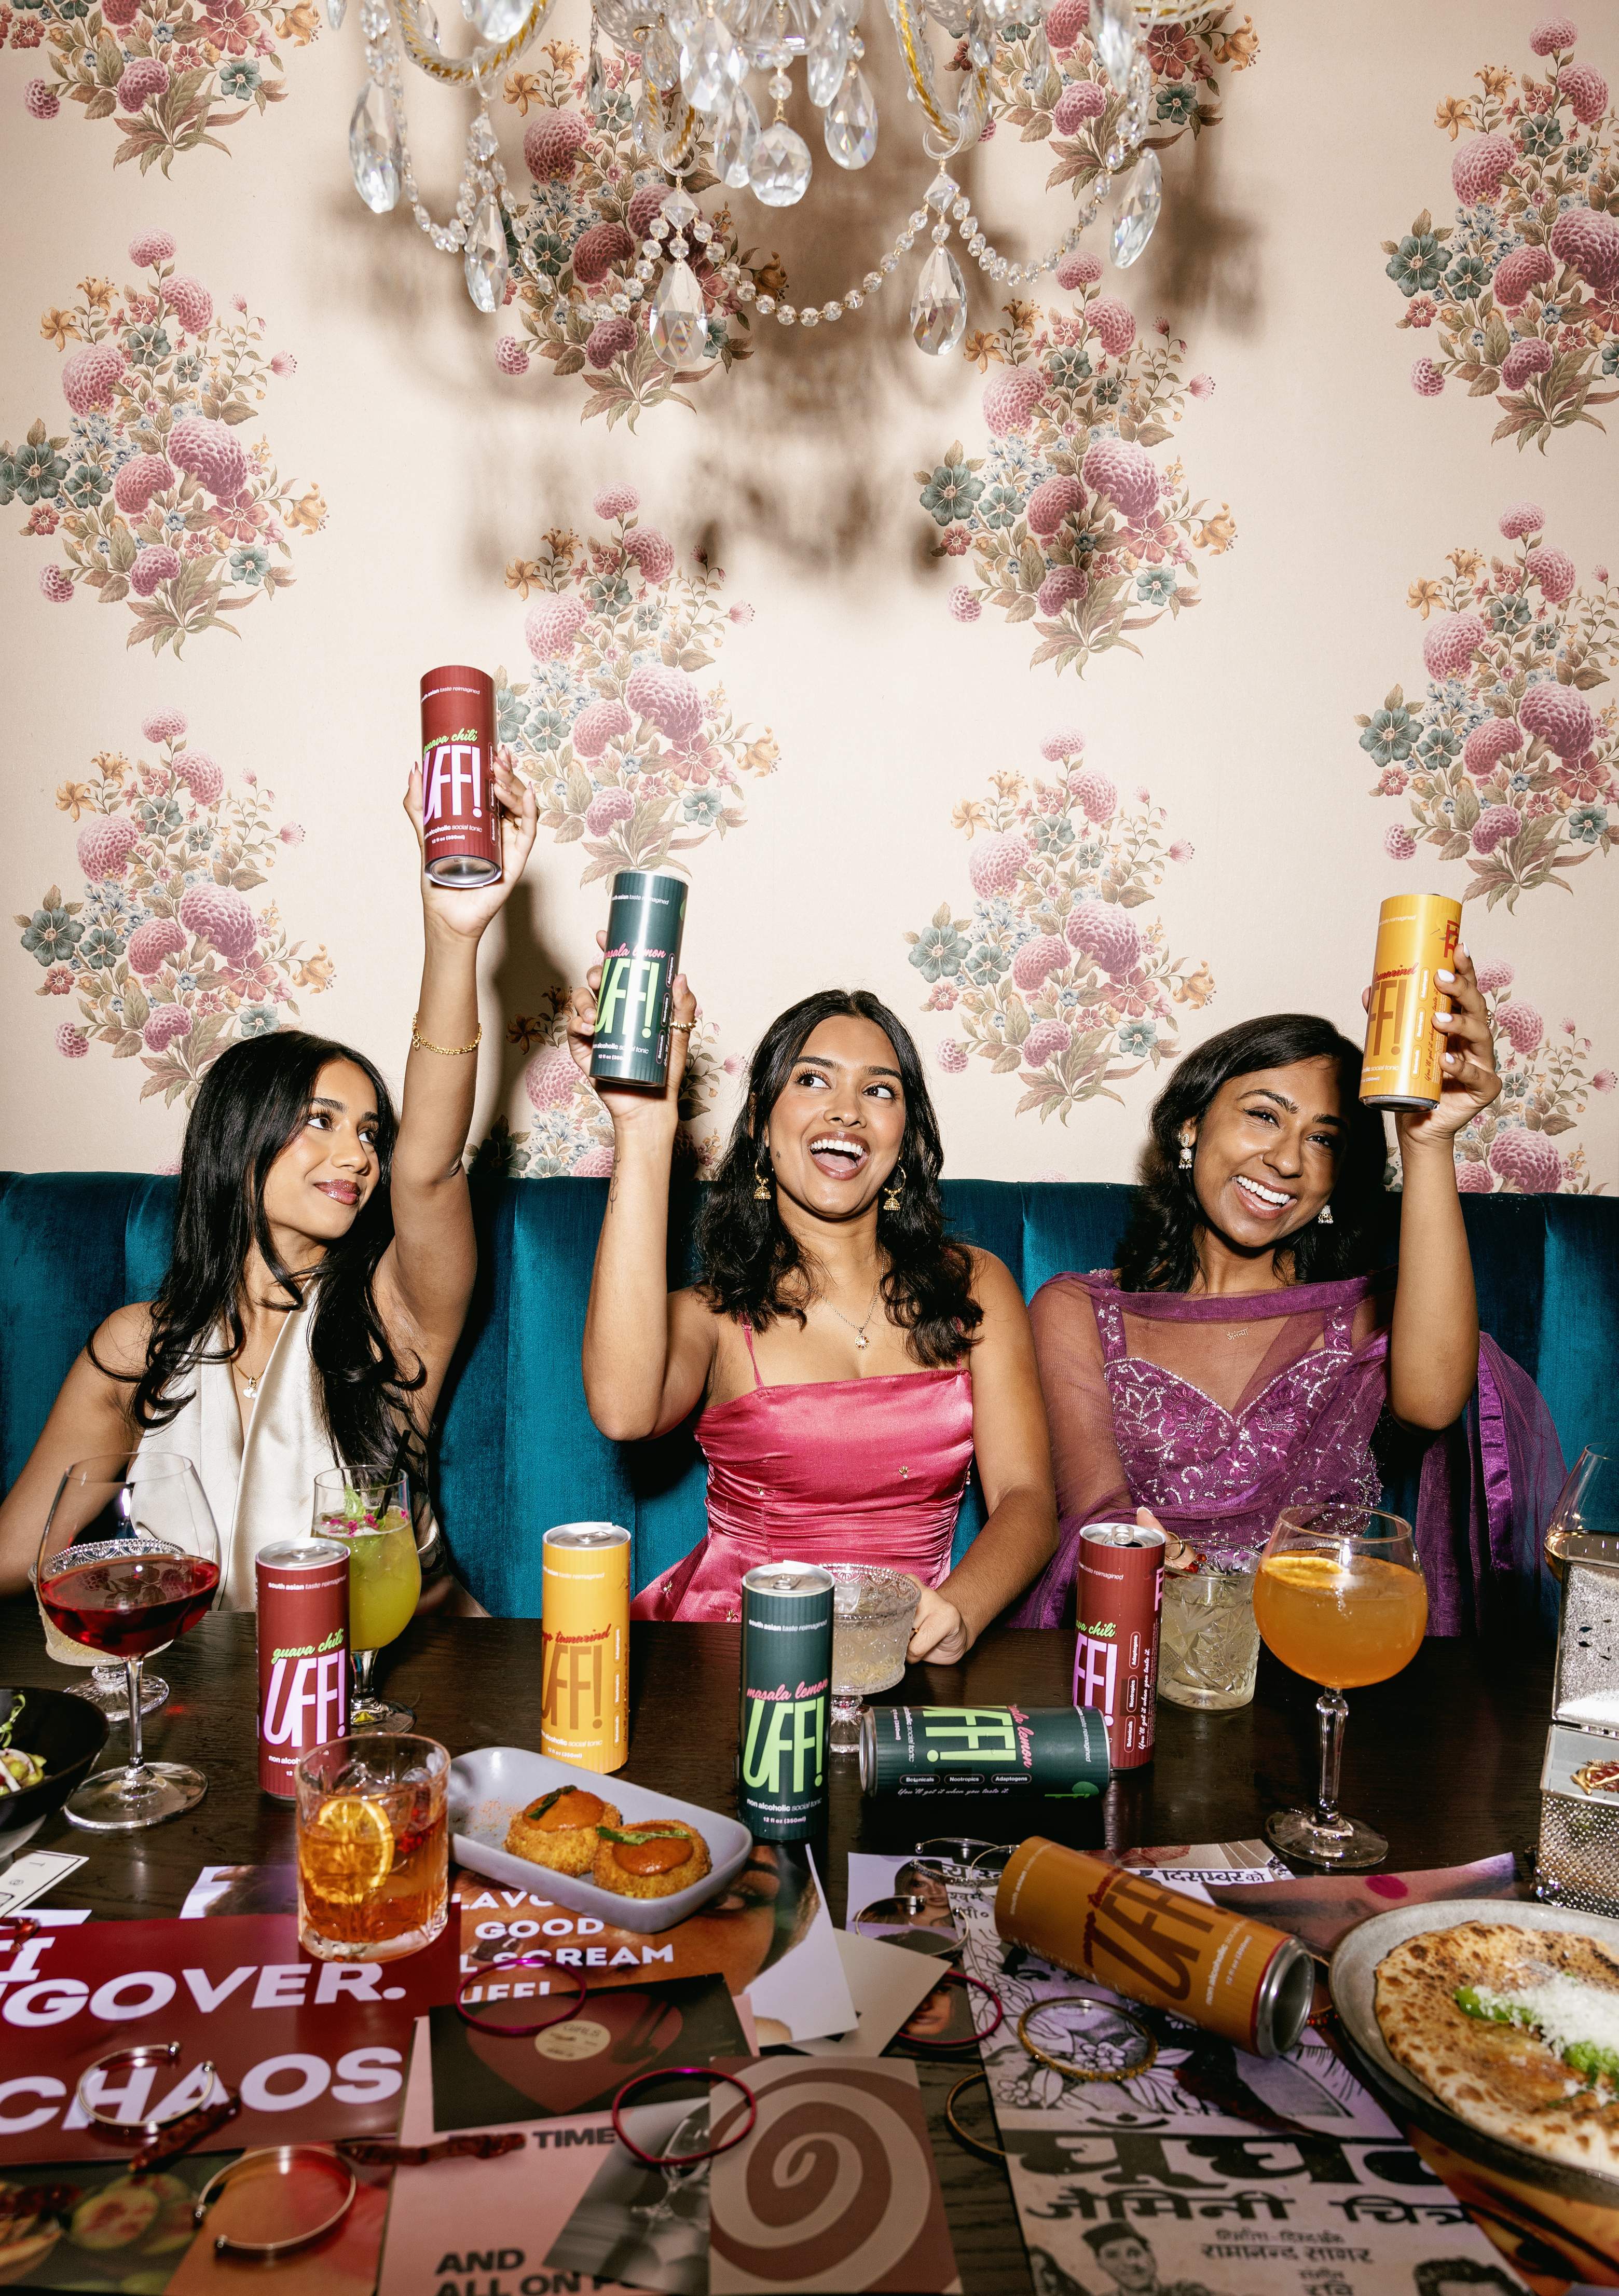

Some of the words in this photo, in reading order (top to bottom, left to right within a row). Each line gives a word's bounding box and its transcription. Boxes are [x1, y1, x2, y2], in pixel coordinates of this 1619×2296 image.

[452, 686, 481, 695] reimagined
[451, 728, 478, 741] chili
[429, 825, 451, 836] alcoholic
[1365, 979, 1407, 1058] FF!
[1083, 1565, 1093, 1574] taste
[1093, 1570, 1124, 1580] reimagined
[555, 1624, 611, 1644] tamarind
[799, 1619, 828, 1631] reimagined
[1088, 1620, 1117, 1637] chili
[271, 1645, 315, 1665] guava
[318, 1628, 345, 1653] chili
[747, 1683, 791, 1701] masala
[795, 1677, 829, 1700] lemon
[1073, 1632, 1118, 1727] FF!
[263, 1648, 346, 1748] UFF!
[545, 1734, 568, 1747] alcoholic
[743, 1695, 825, 1794] UFF!
[922, 1706, 1017, 1762] FF!
[1082, 1728, 1091, 1763] reimagined
[1017, 1726, 1035, 1768] lemon
[747, 1798, 758, 1808] non
[758, 1802, 791, 1811] alcoholic
[791, 1801, 811, 1811] social
[784, 1816, 806, 1824] (350ml)
[1246, 1871, 1265, 1882] को
[475, 1918, 605, 1940] GOOD
[492, 1944, 674, 1971] SCREAM
[0, 1962, 407, 2028] GOVER.
[0, 2047, 403, 2135] CHAOS
[532, 2126, 616, 2149] TIME
[434, 2247, 525, 2276] AND
[520, 2271, 582, 2295] ON
